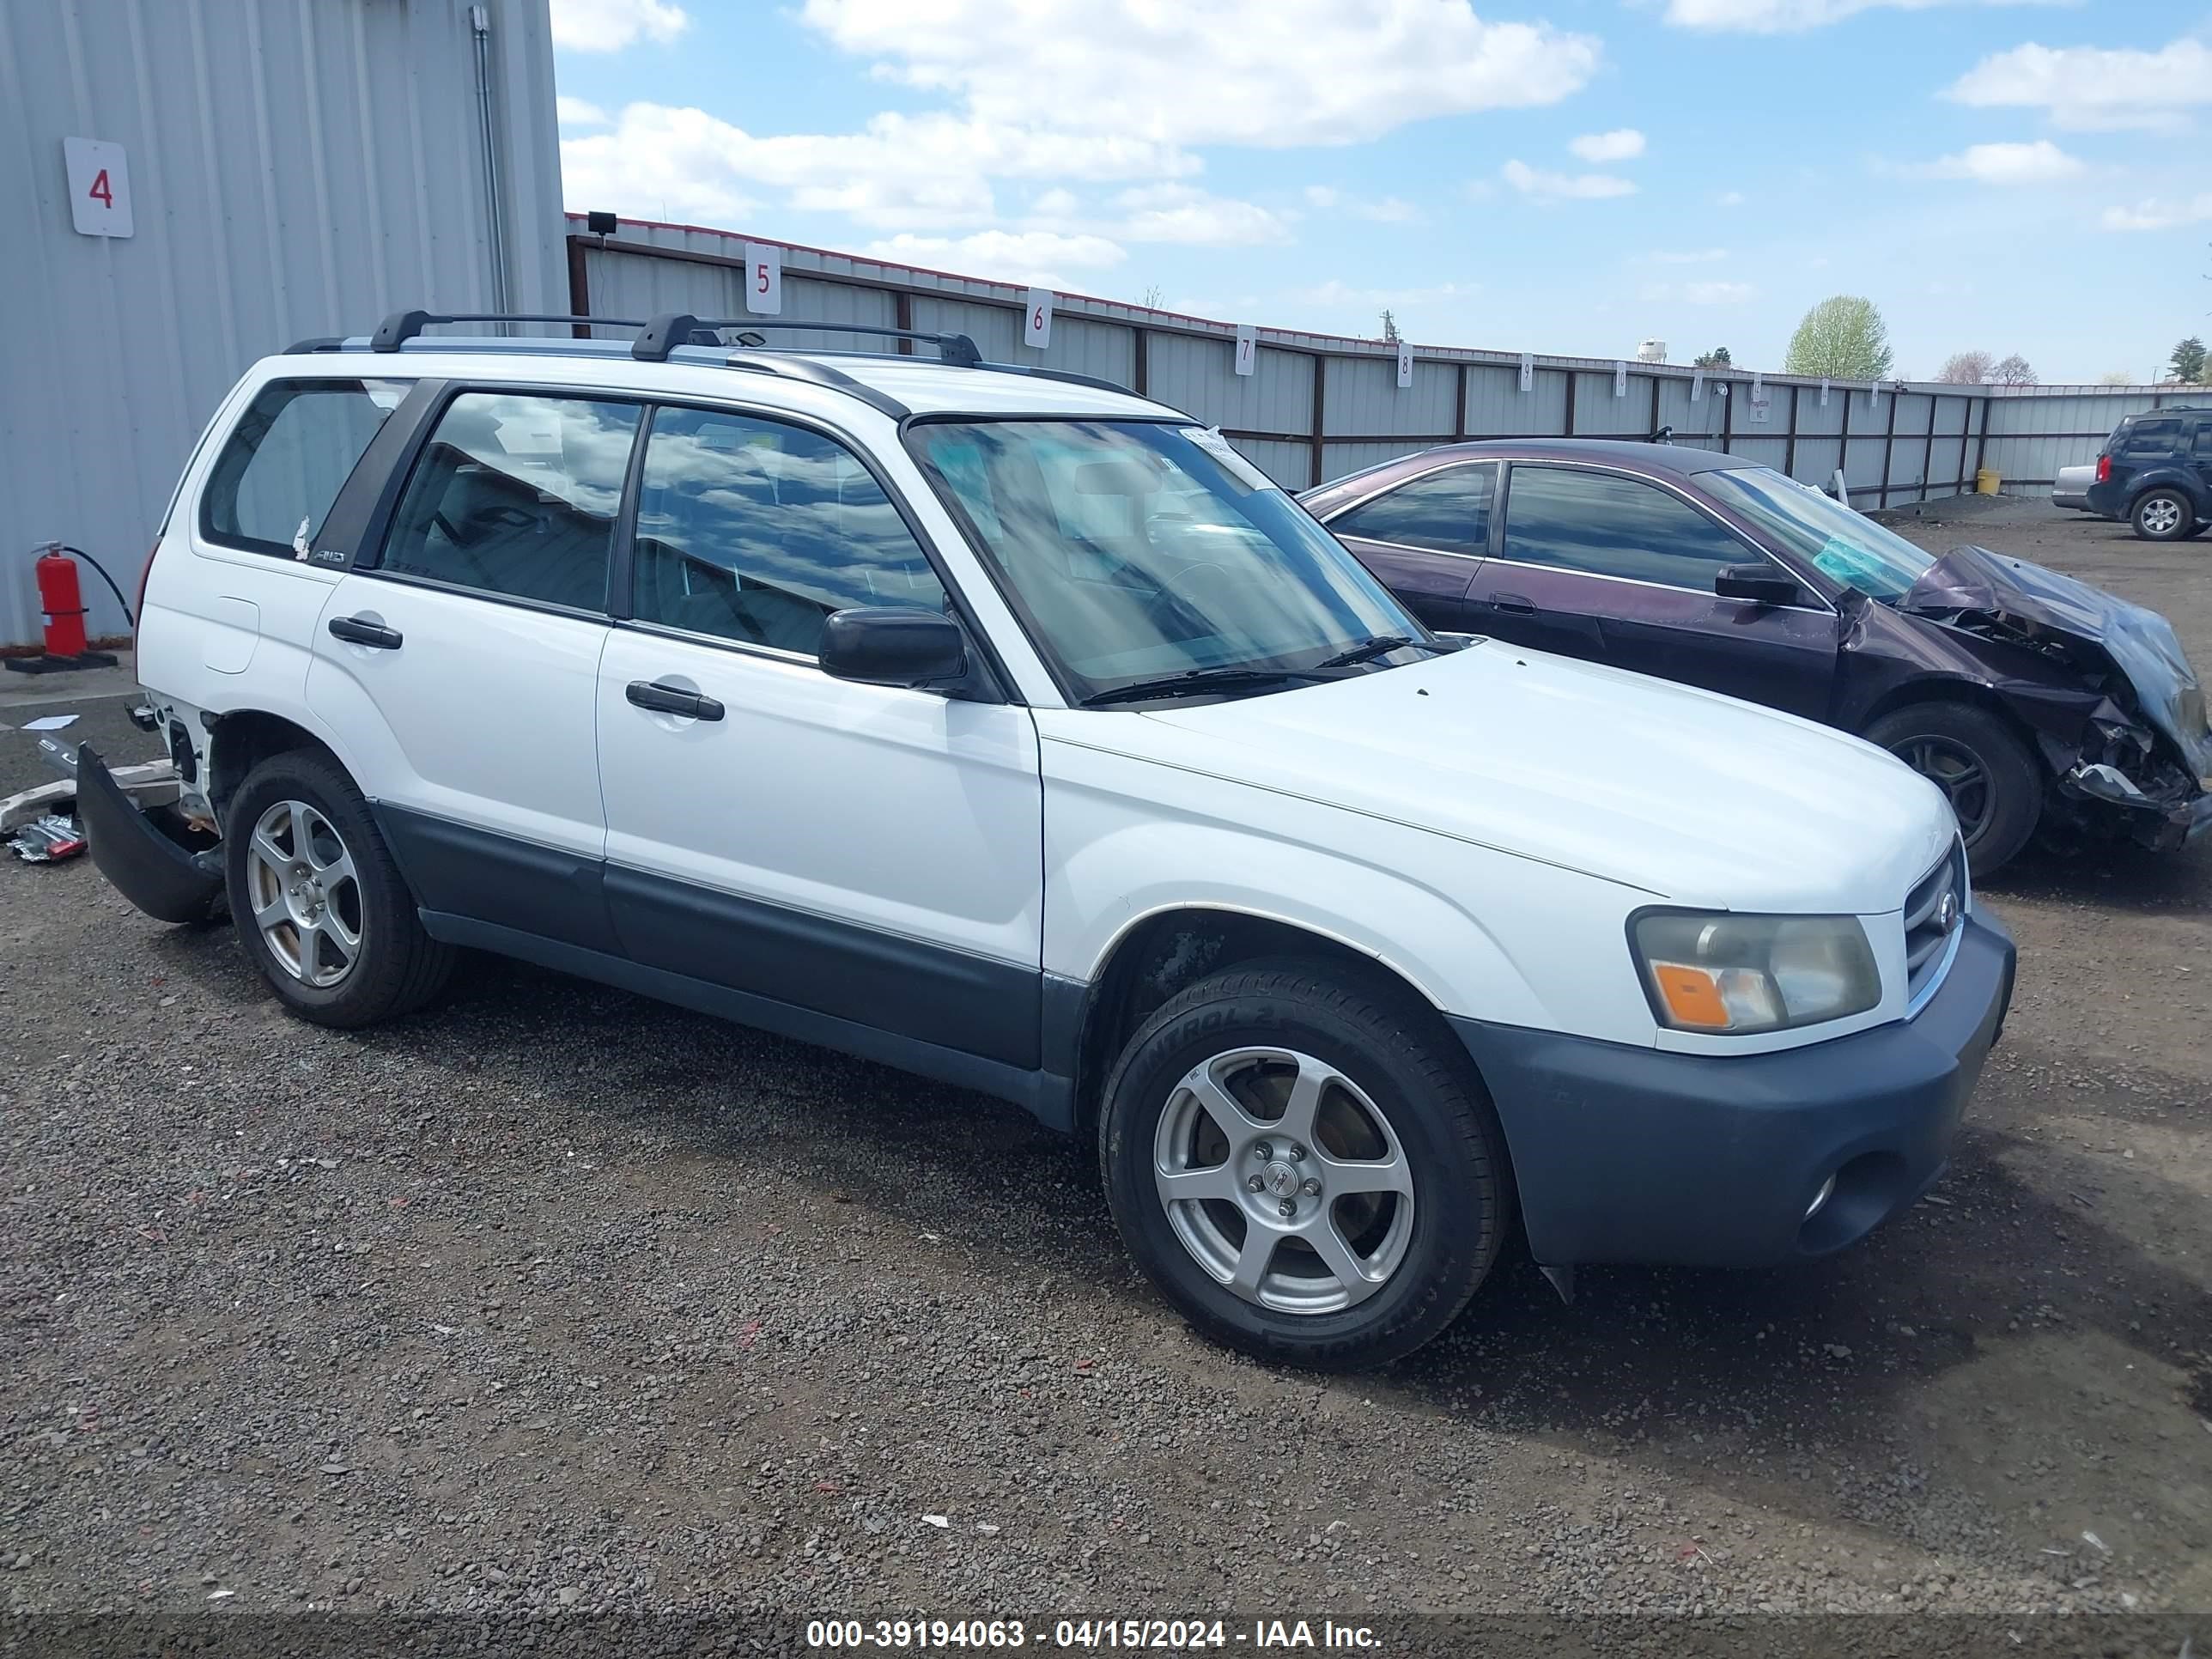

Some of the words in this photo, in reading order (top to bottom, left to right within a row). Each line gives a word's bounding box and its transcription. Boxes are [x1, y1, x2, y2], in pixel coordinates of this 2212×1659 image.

[89, 169, 112, 210] 4
[757, 264, 769, 294] 5
[1034, 306, 1043, 330] 6
[1243, 339, 1249, 361] 7
[1402, 356, 1408, 374] 8
[1524, 363, 1530, 379] 9
[1617, 371, 1625, 386] 10
